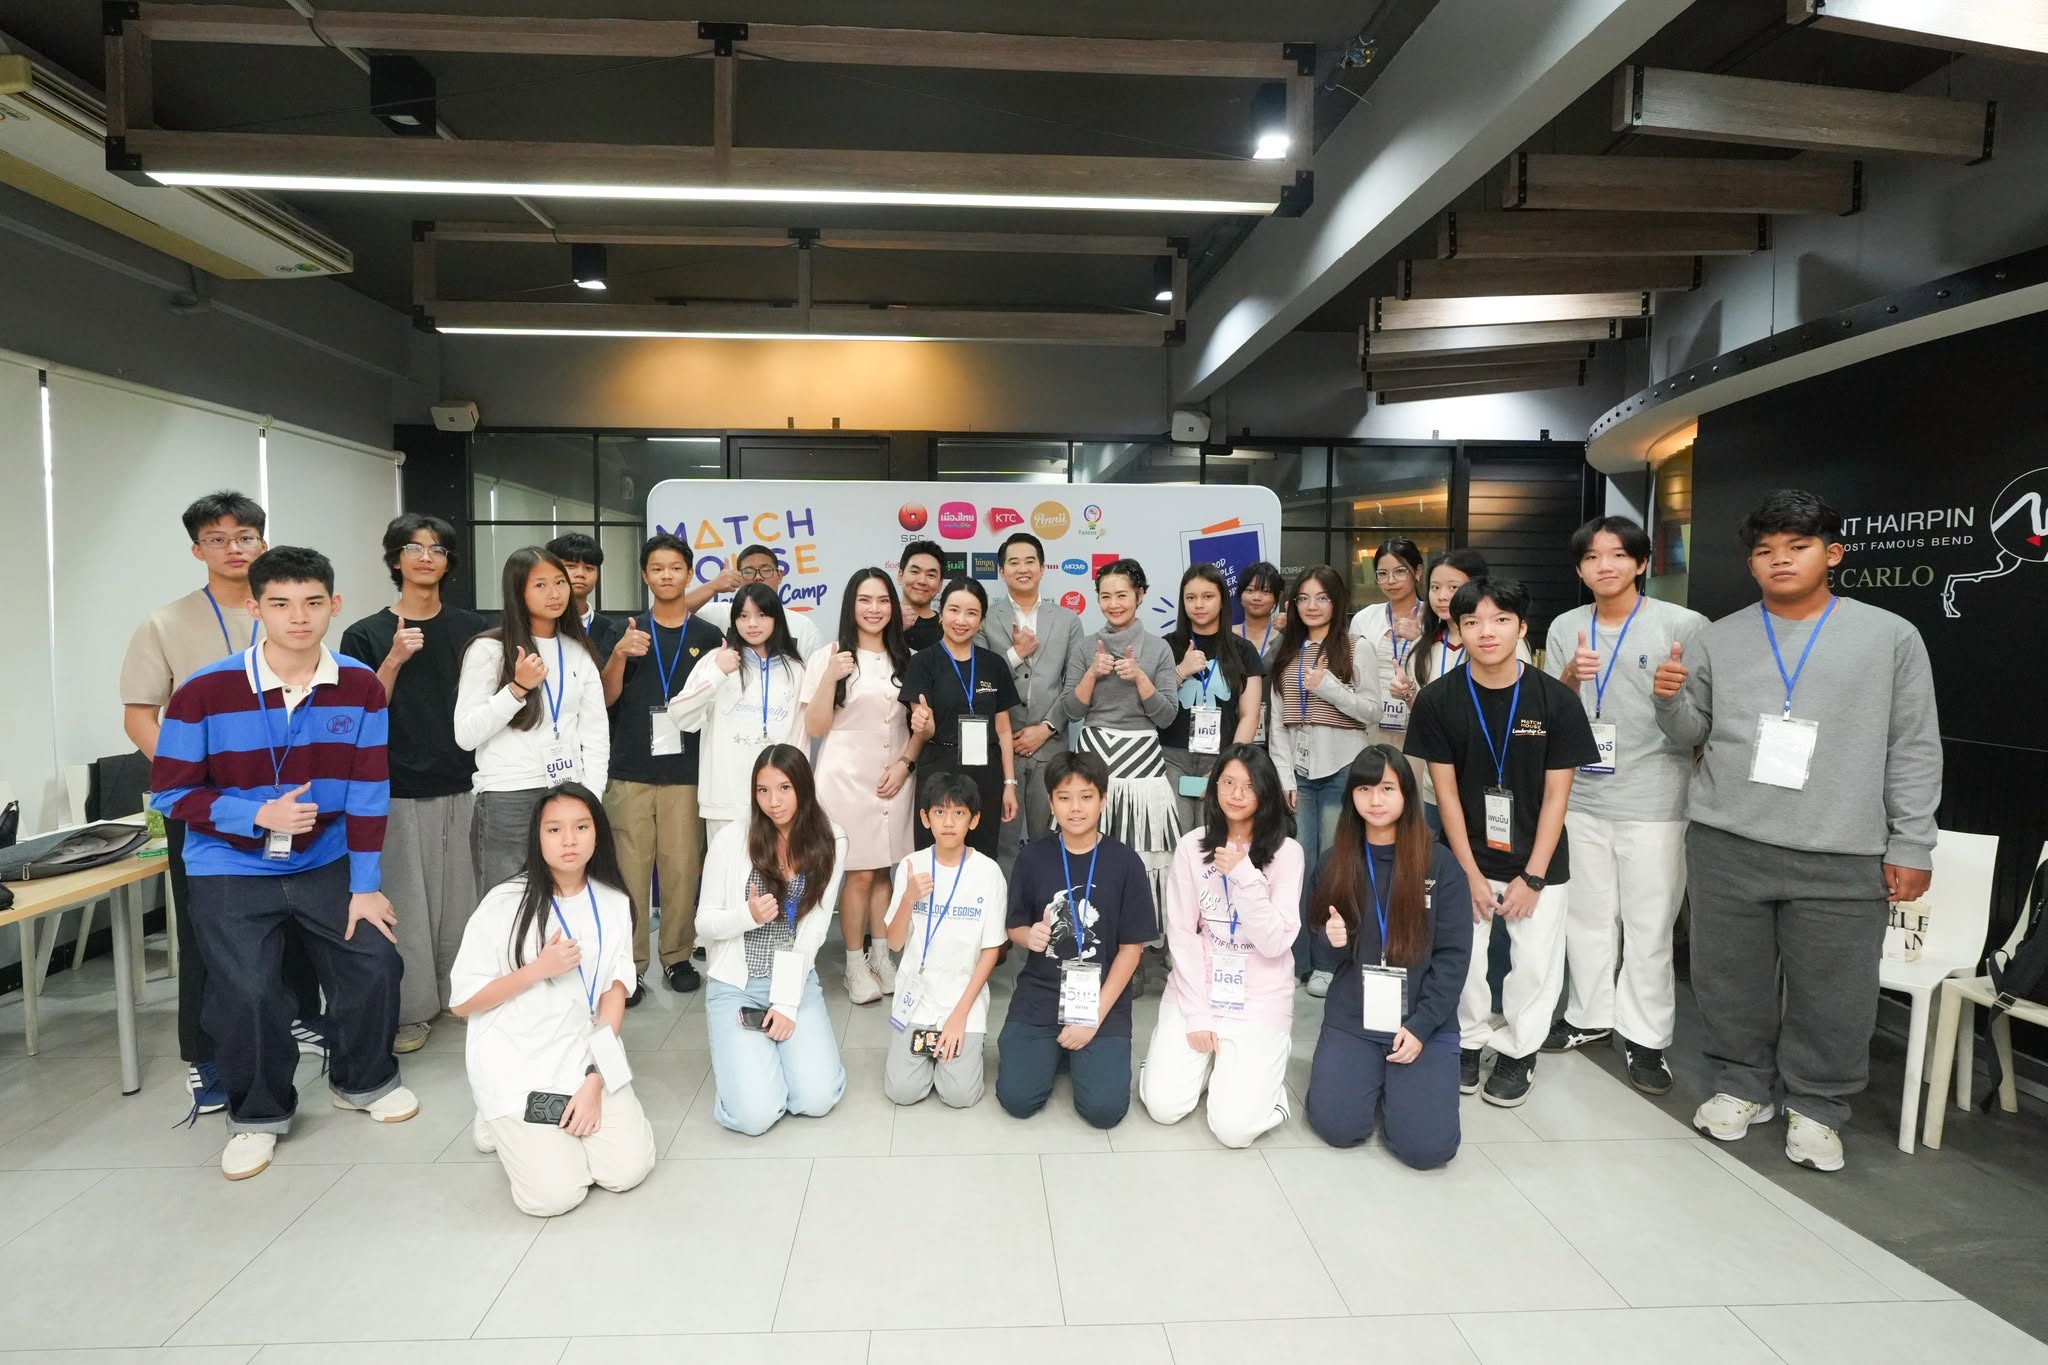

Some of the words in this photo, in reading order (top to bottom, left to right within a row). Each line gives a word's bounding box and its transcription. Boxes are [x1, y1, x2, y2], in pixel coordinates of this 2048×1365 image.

[995, 513, 1017, 523] KTC
[1866, 507, 1974, 535] HAIRPIN
[1870, 538, 1925, 550] FAMOUS
[1931, 535, 1973, 546] BEND
[1840, 565, 1935, 589] CARLO
[778, 583, 828, 606] Camp
[952, 906, 982, 918] EGOISM
